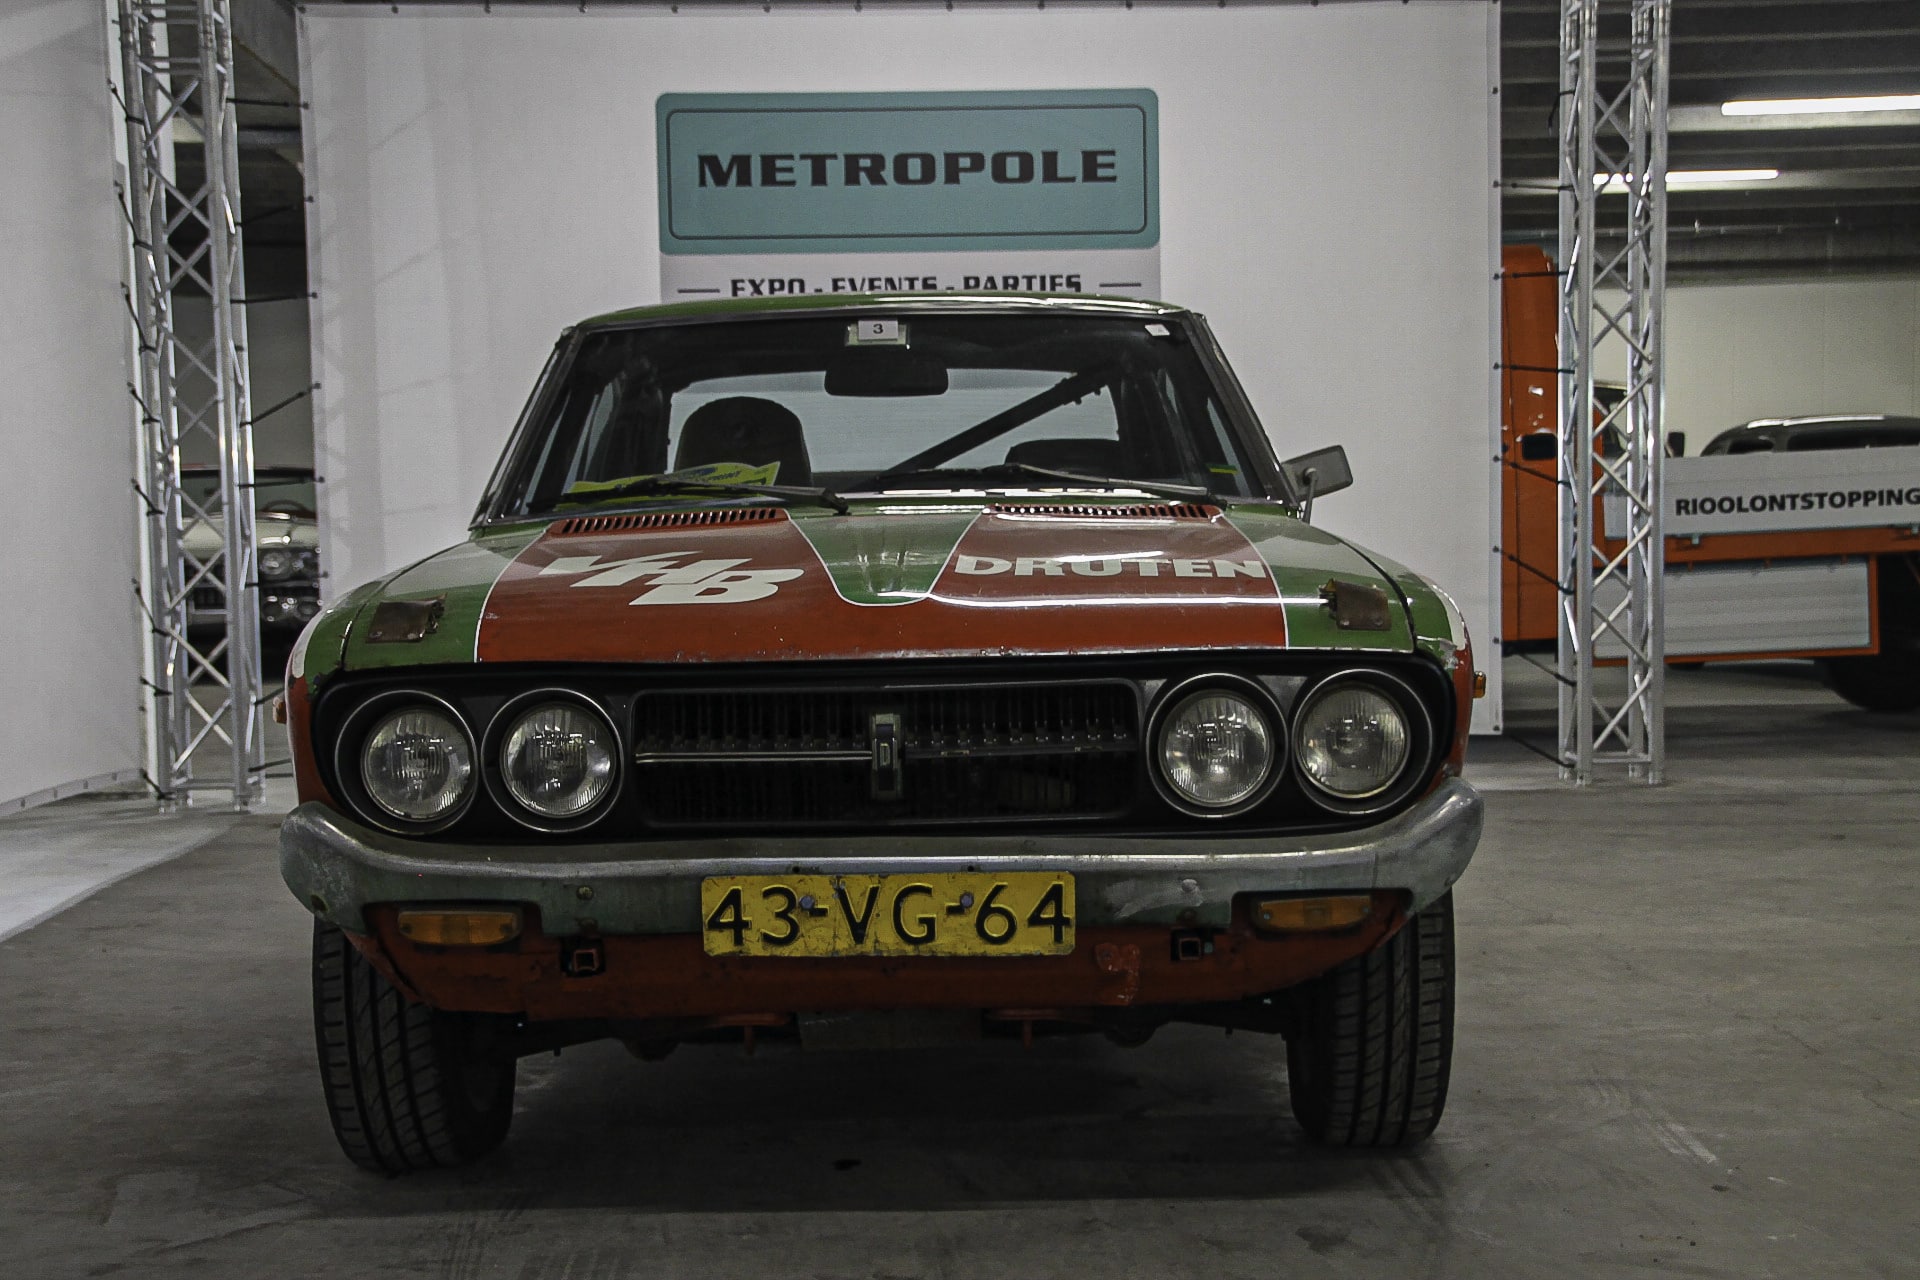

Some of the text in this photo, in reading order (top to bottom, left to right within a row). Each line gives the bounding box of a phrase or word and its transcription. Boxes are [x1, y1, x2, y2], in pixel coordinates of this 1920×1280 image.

[698, 150, 1117, 187] METROPOLE
[731, 278, 805, 297] EXPO
[873, 323, 884, 334] 3
[1675, 487, 1920, 516] RIOOLONTSTOPPING
[954, 554, 1267, 578] DRUTEN
[705, 882, 1072, 946] 43-VG-64
